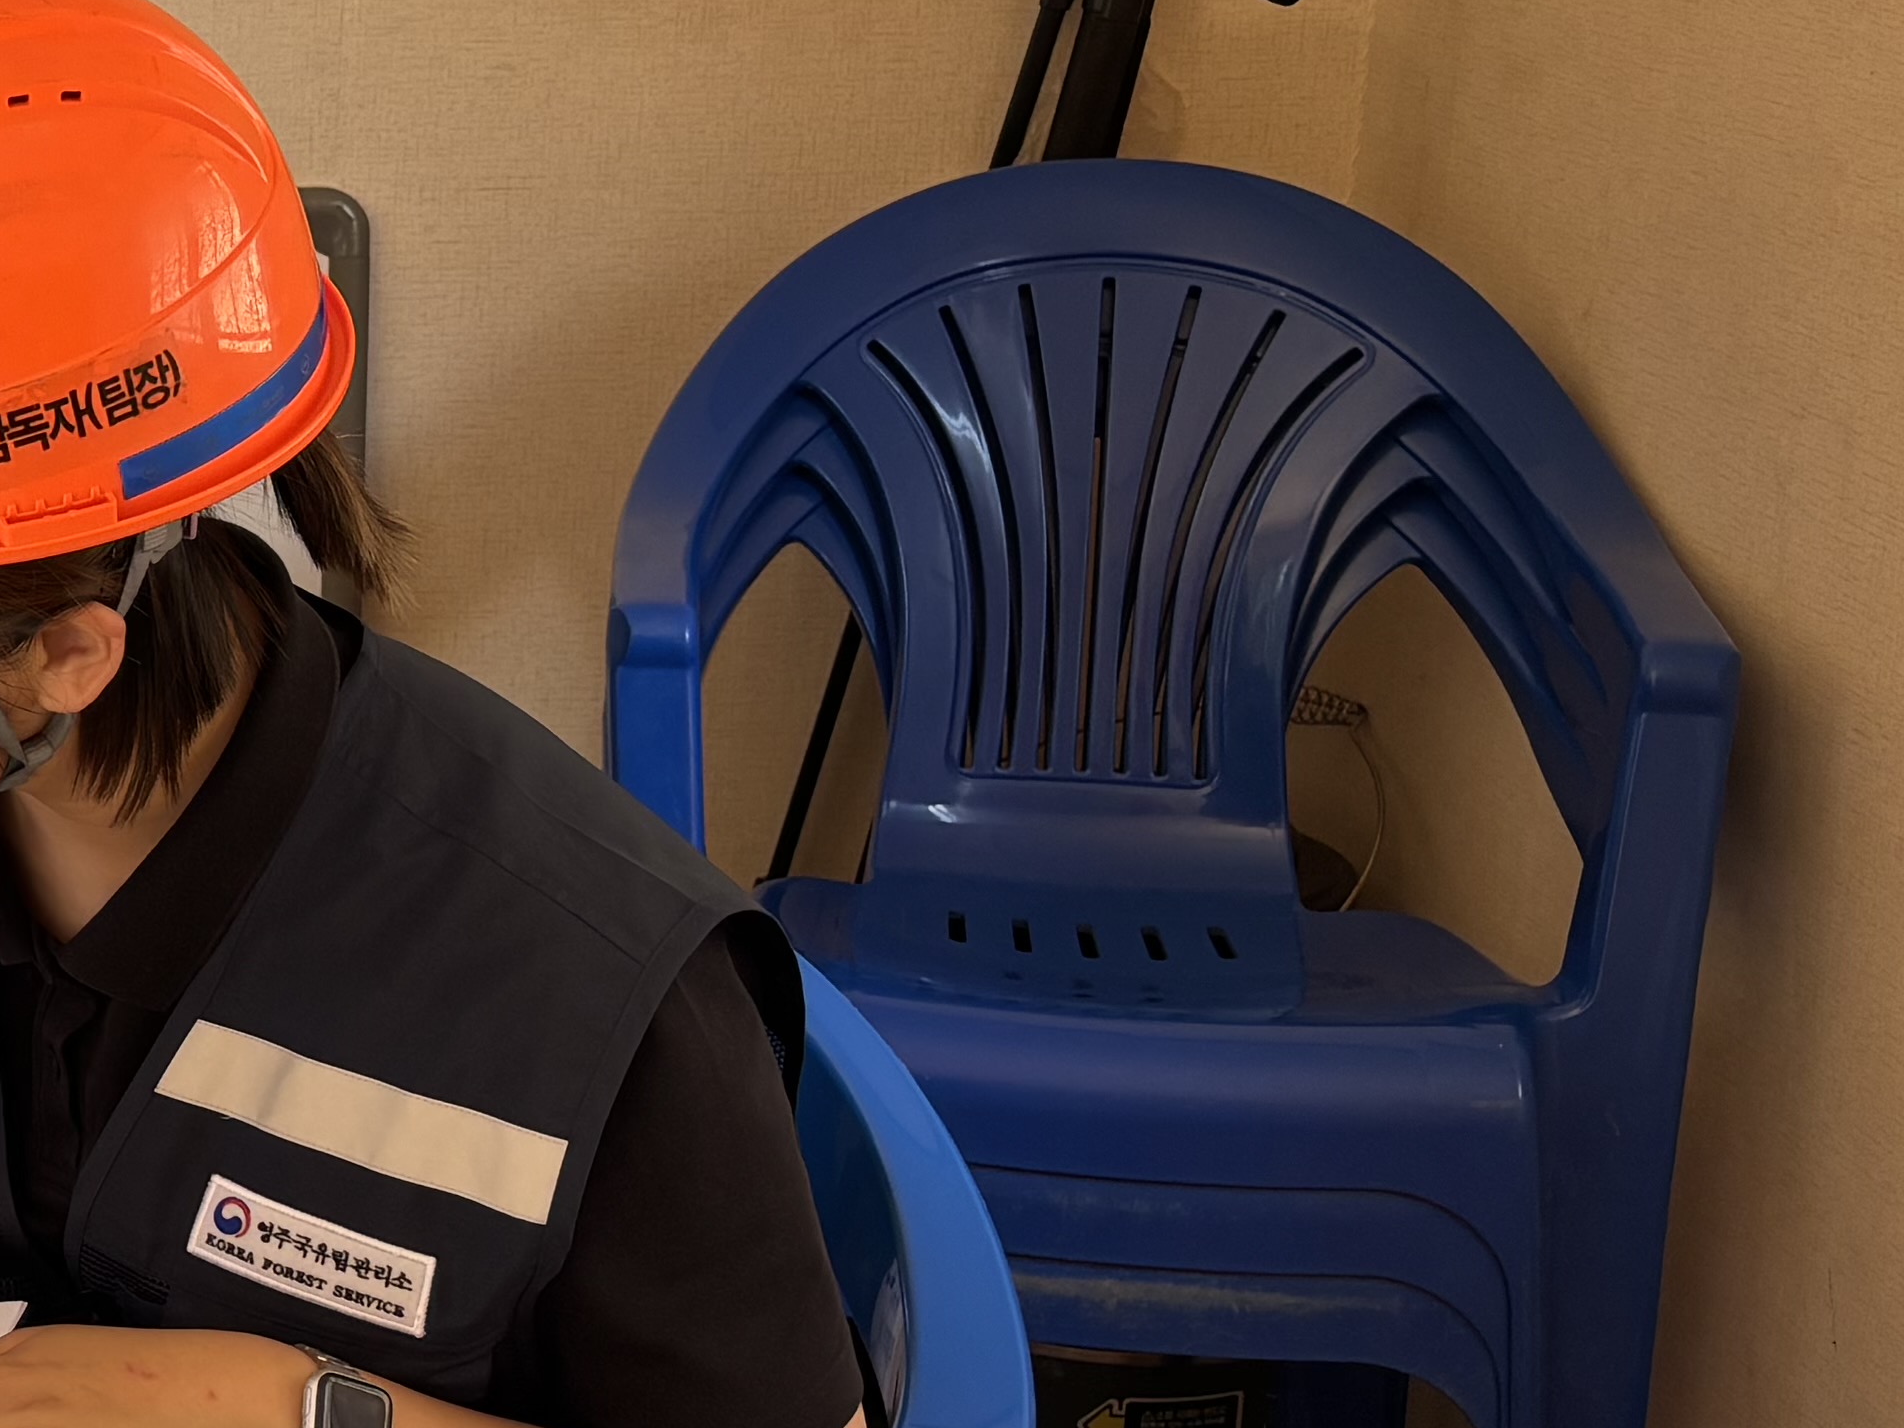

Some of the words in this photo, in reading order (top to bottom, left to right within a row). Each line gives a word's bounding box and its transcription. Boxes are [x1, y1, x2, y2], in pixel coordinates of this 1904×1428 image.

[205, 1232, 254, 1265] KOREA
[262, 1257, 328, 1291] FOREST
[332, 1284, 406, 1319] SERVICE
[257, 1220, 414, 1293] 영주국유림관리소
